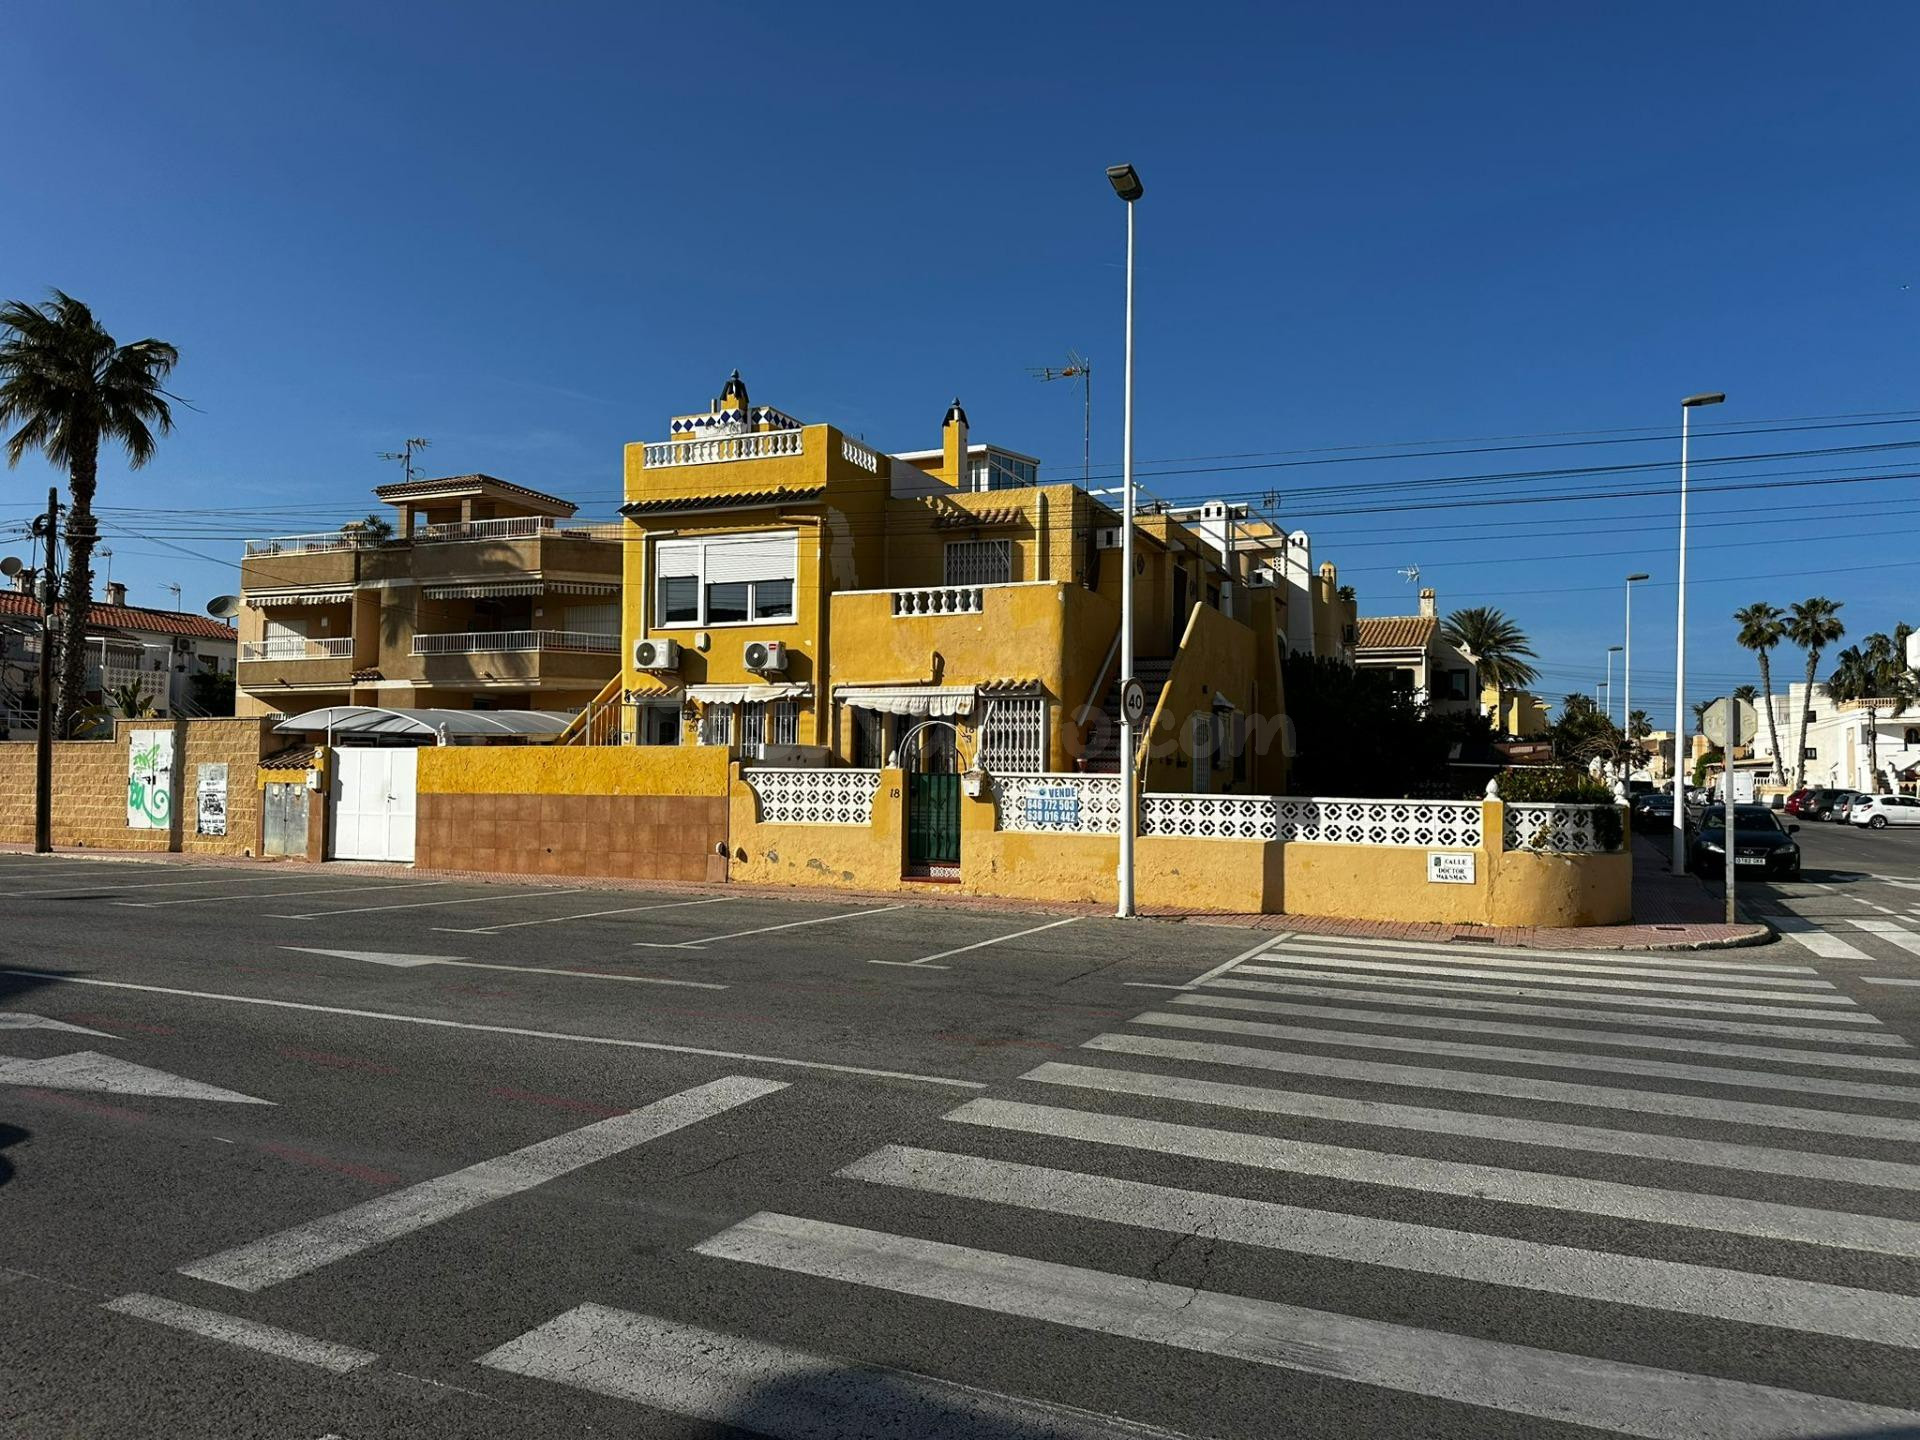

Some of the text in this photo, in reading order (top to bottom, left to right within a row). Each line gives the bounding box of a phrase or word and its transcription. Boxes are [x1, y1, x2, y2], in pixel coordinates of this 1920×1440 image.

[1128, 694, 1142, 710] 40
[890, 788, 901, 799] 18
[1049, 787, 1076, 798] VENDE
[1027, 799, 1075, 811] 646 772 503
[1044, 810, 1059, 822] 016
[1060, 811, 1076, 822] 442
